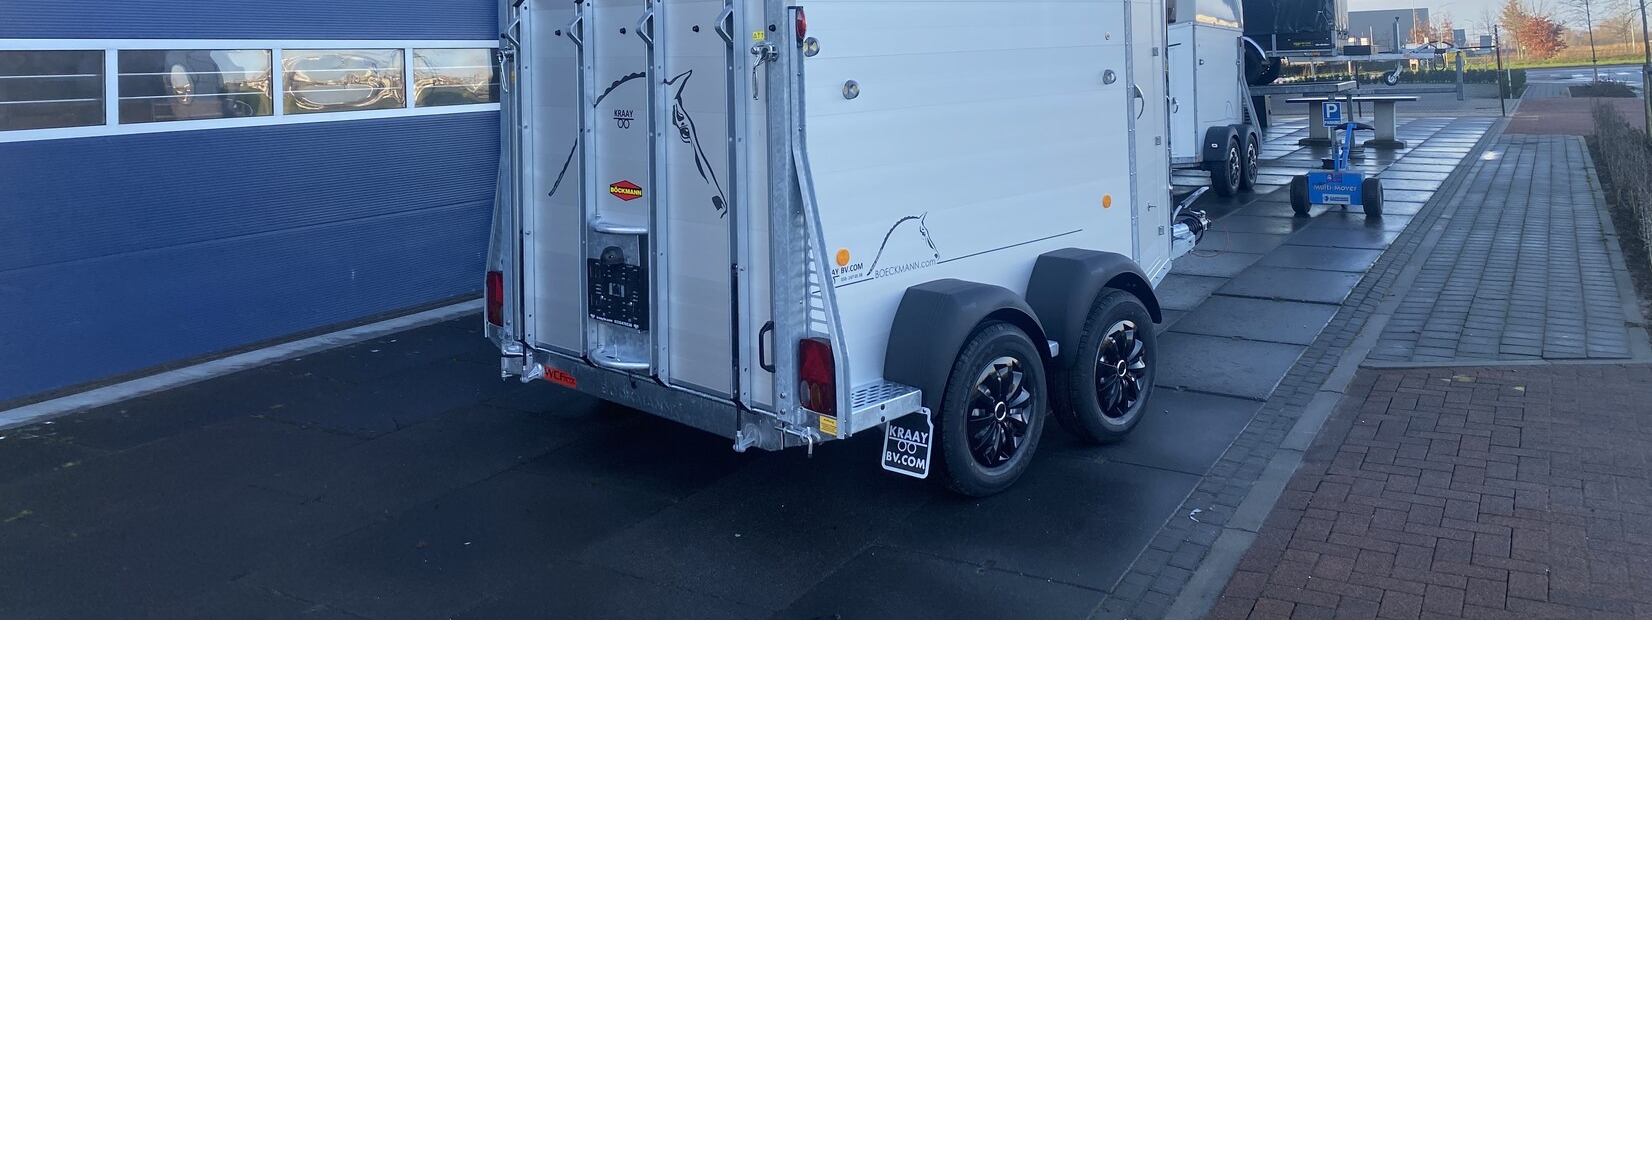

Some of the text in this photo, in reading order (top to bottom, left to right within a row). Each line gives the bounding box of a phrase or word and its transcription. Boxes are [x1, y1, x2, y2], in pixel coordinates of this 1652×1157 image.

[614, 109, 634, 117] KRAAY
[1326, 103, 1338, 118] P
[840, 263, 864, 274] BV.COM
[874, 258, 937, 279] BOECKMANN.com
[889, 424, 929, 444] KRAAY
[885, 450, 926, 470] BV.COM
